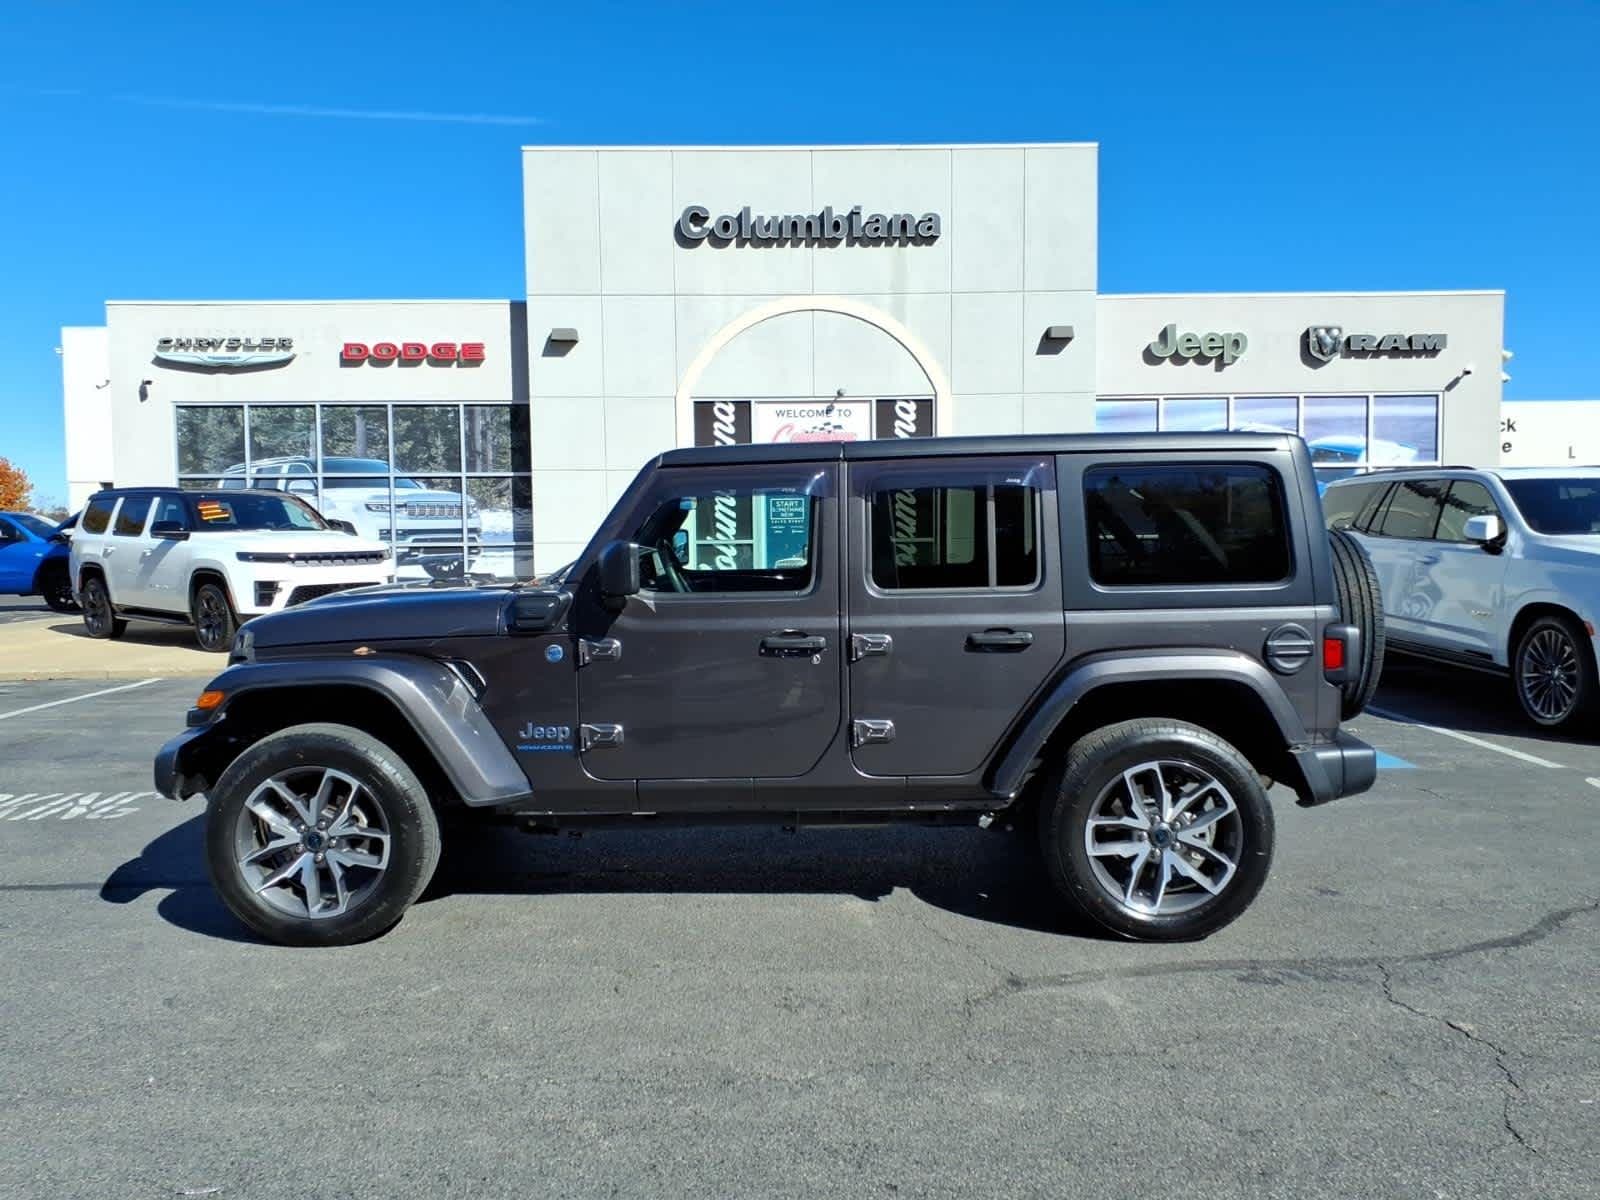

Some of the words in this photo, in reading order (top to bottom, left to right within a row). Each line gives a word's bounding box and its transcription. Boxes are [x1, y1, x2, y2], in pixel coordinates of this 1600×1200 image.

[679, 205, 941, 240] Columbiana
[157, 337, 293, 349] CHRYSLER
[343, 342, 486, 361] DODGE
[1150, 324, 1248, 364] Jeep
[1348, 334, 1448, 351] RAM
[837, 409, 852, 417] TO
[519, 722, 570, 742] Jeep
